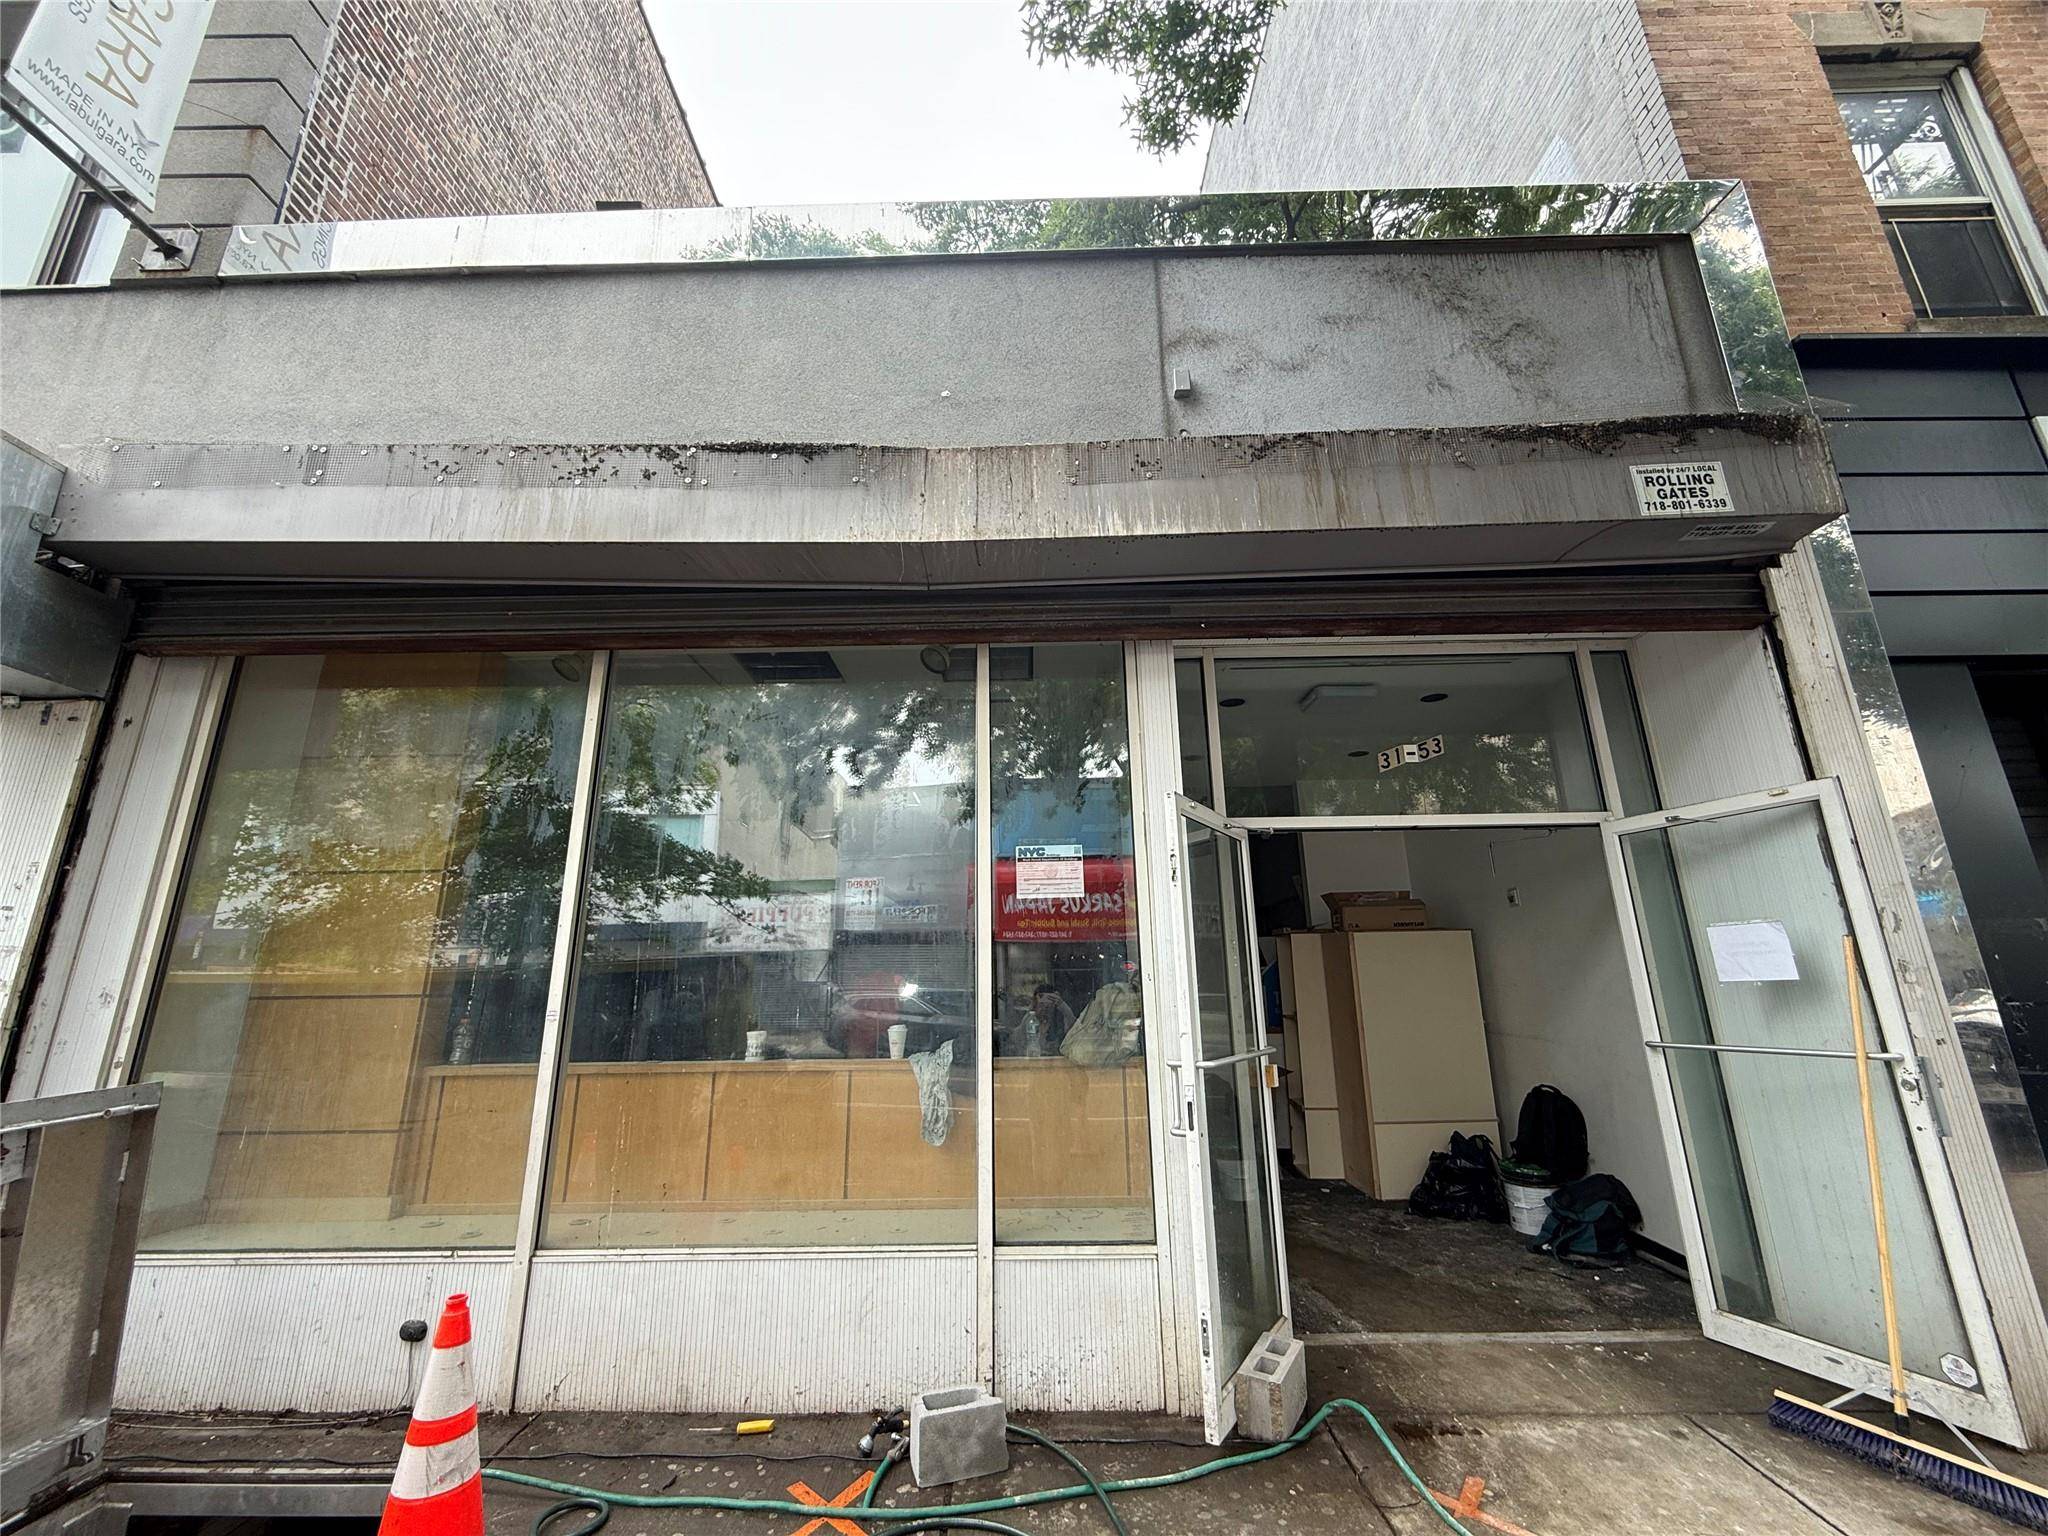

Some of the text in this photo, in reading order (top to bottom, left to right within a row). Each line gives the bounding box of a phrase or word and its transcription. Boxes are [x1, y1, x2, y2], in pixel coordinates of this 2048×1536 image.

[45, 57, 148, 161] MADE IN NYC
[27, 58, 156, 184] www.labulgara.com
[1636, 467, 1665, 475] Installed
[1666, 467, 1674, 475] by
[1644, 473, 1715, 488] ROLLING
[1657, 486, 1710, 500] GATES
[1644, 498, 1727, 511] 718-801-6339
[1380, 737, 1443, 769] 31-53
[1018, 847, 1046, 857] NYC
